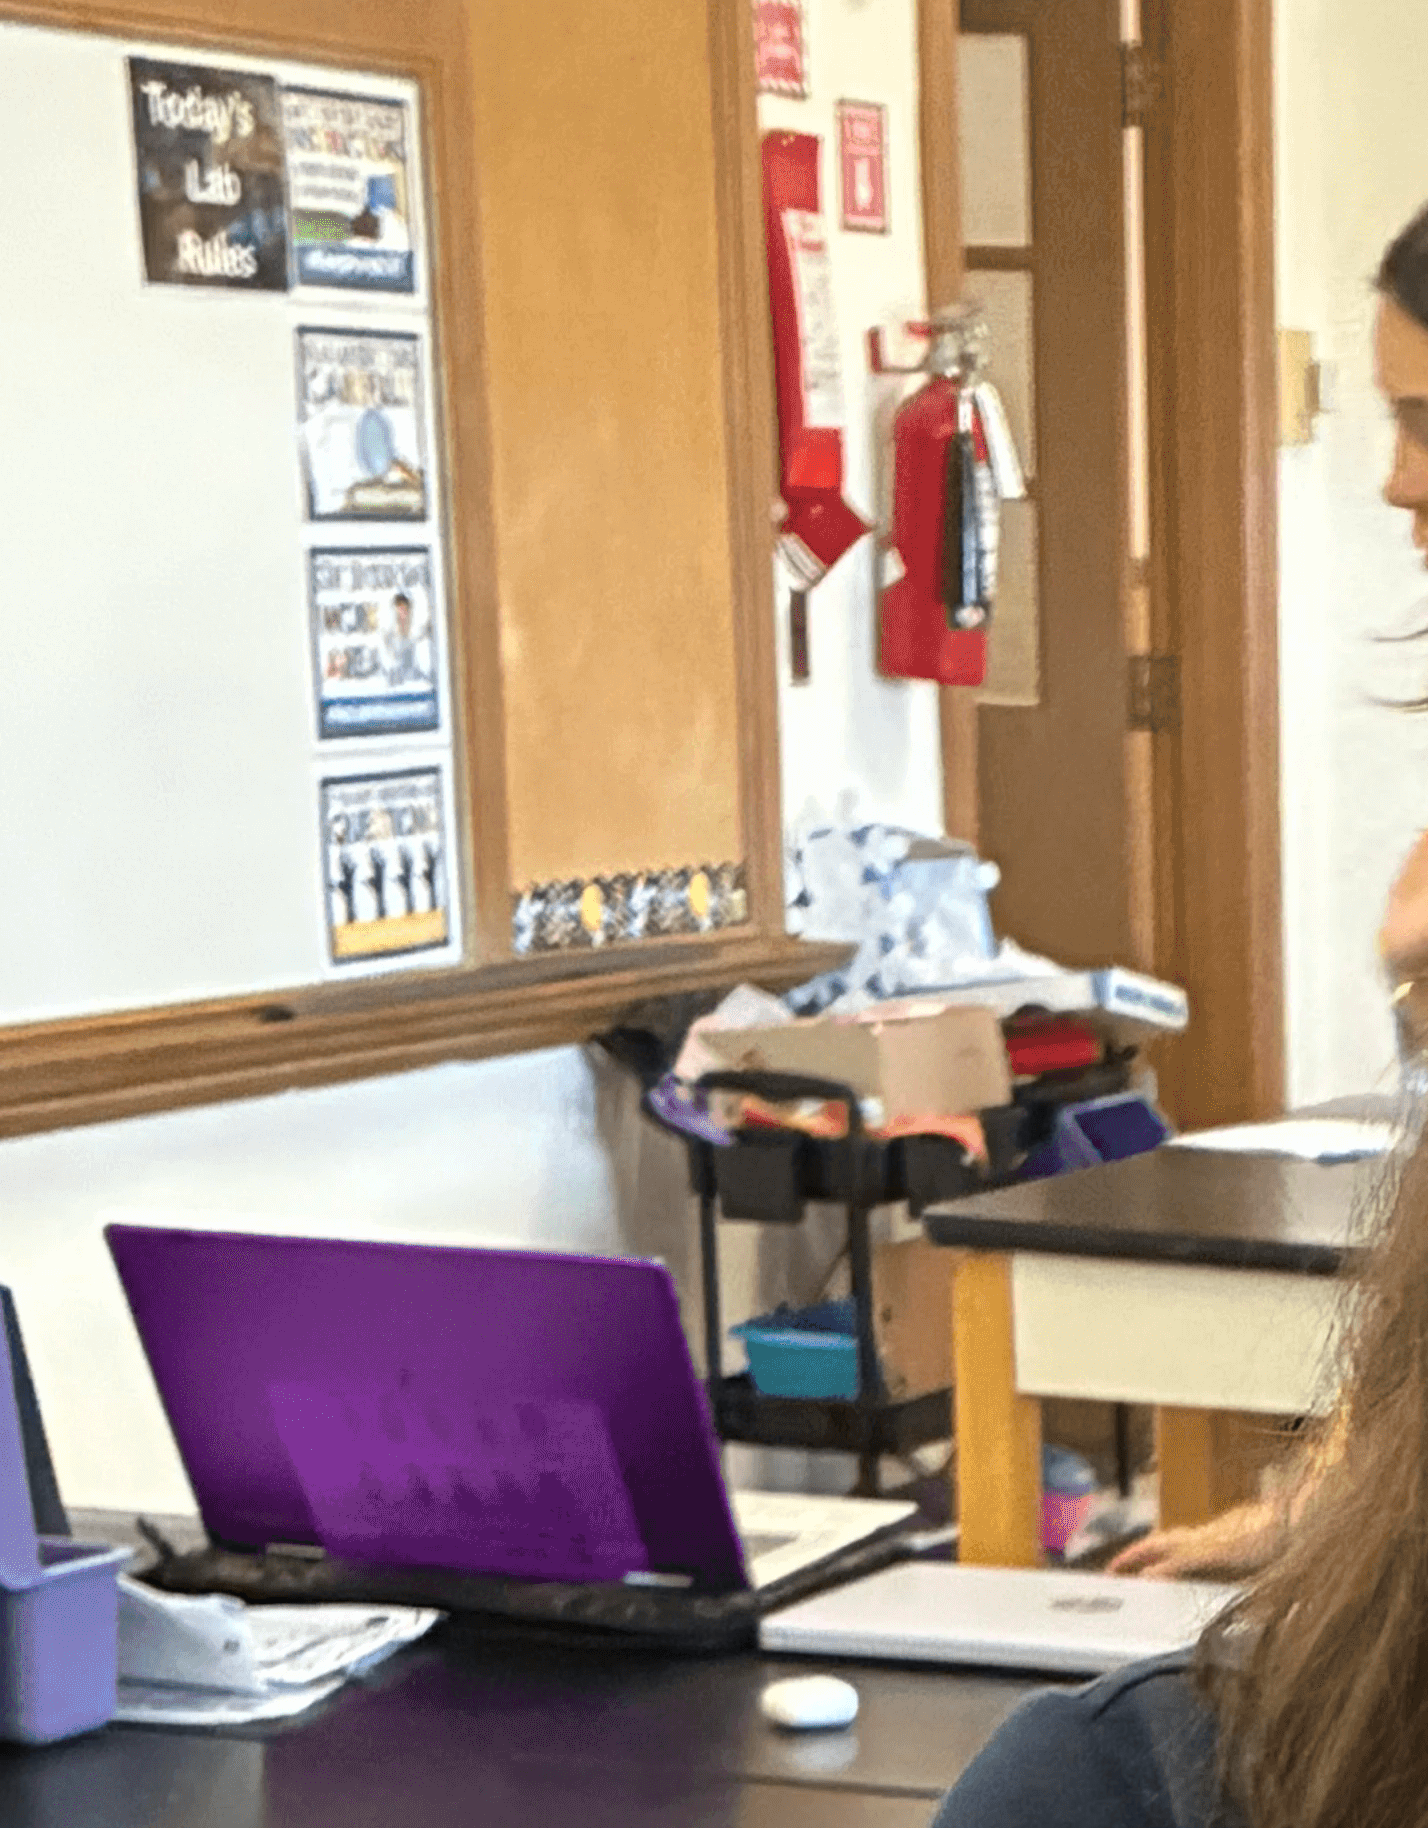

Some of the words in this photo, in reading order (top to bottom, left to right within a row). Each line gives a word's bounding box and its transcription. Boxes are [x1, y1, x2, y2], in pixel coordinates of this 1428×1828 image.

[139, 80, 254, 145] Today's
[184, 158, 242, 206] Lab
[175, 229, 258, 278] Rules
